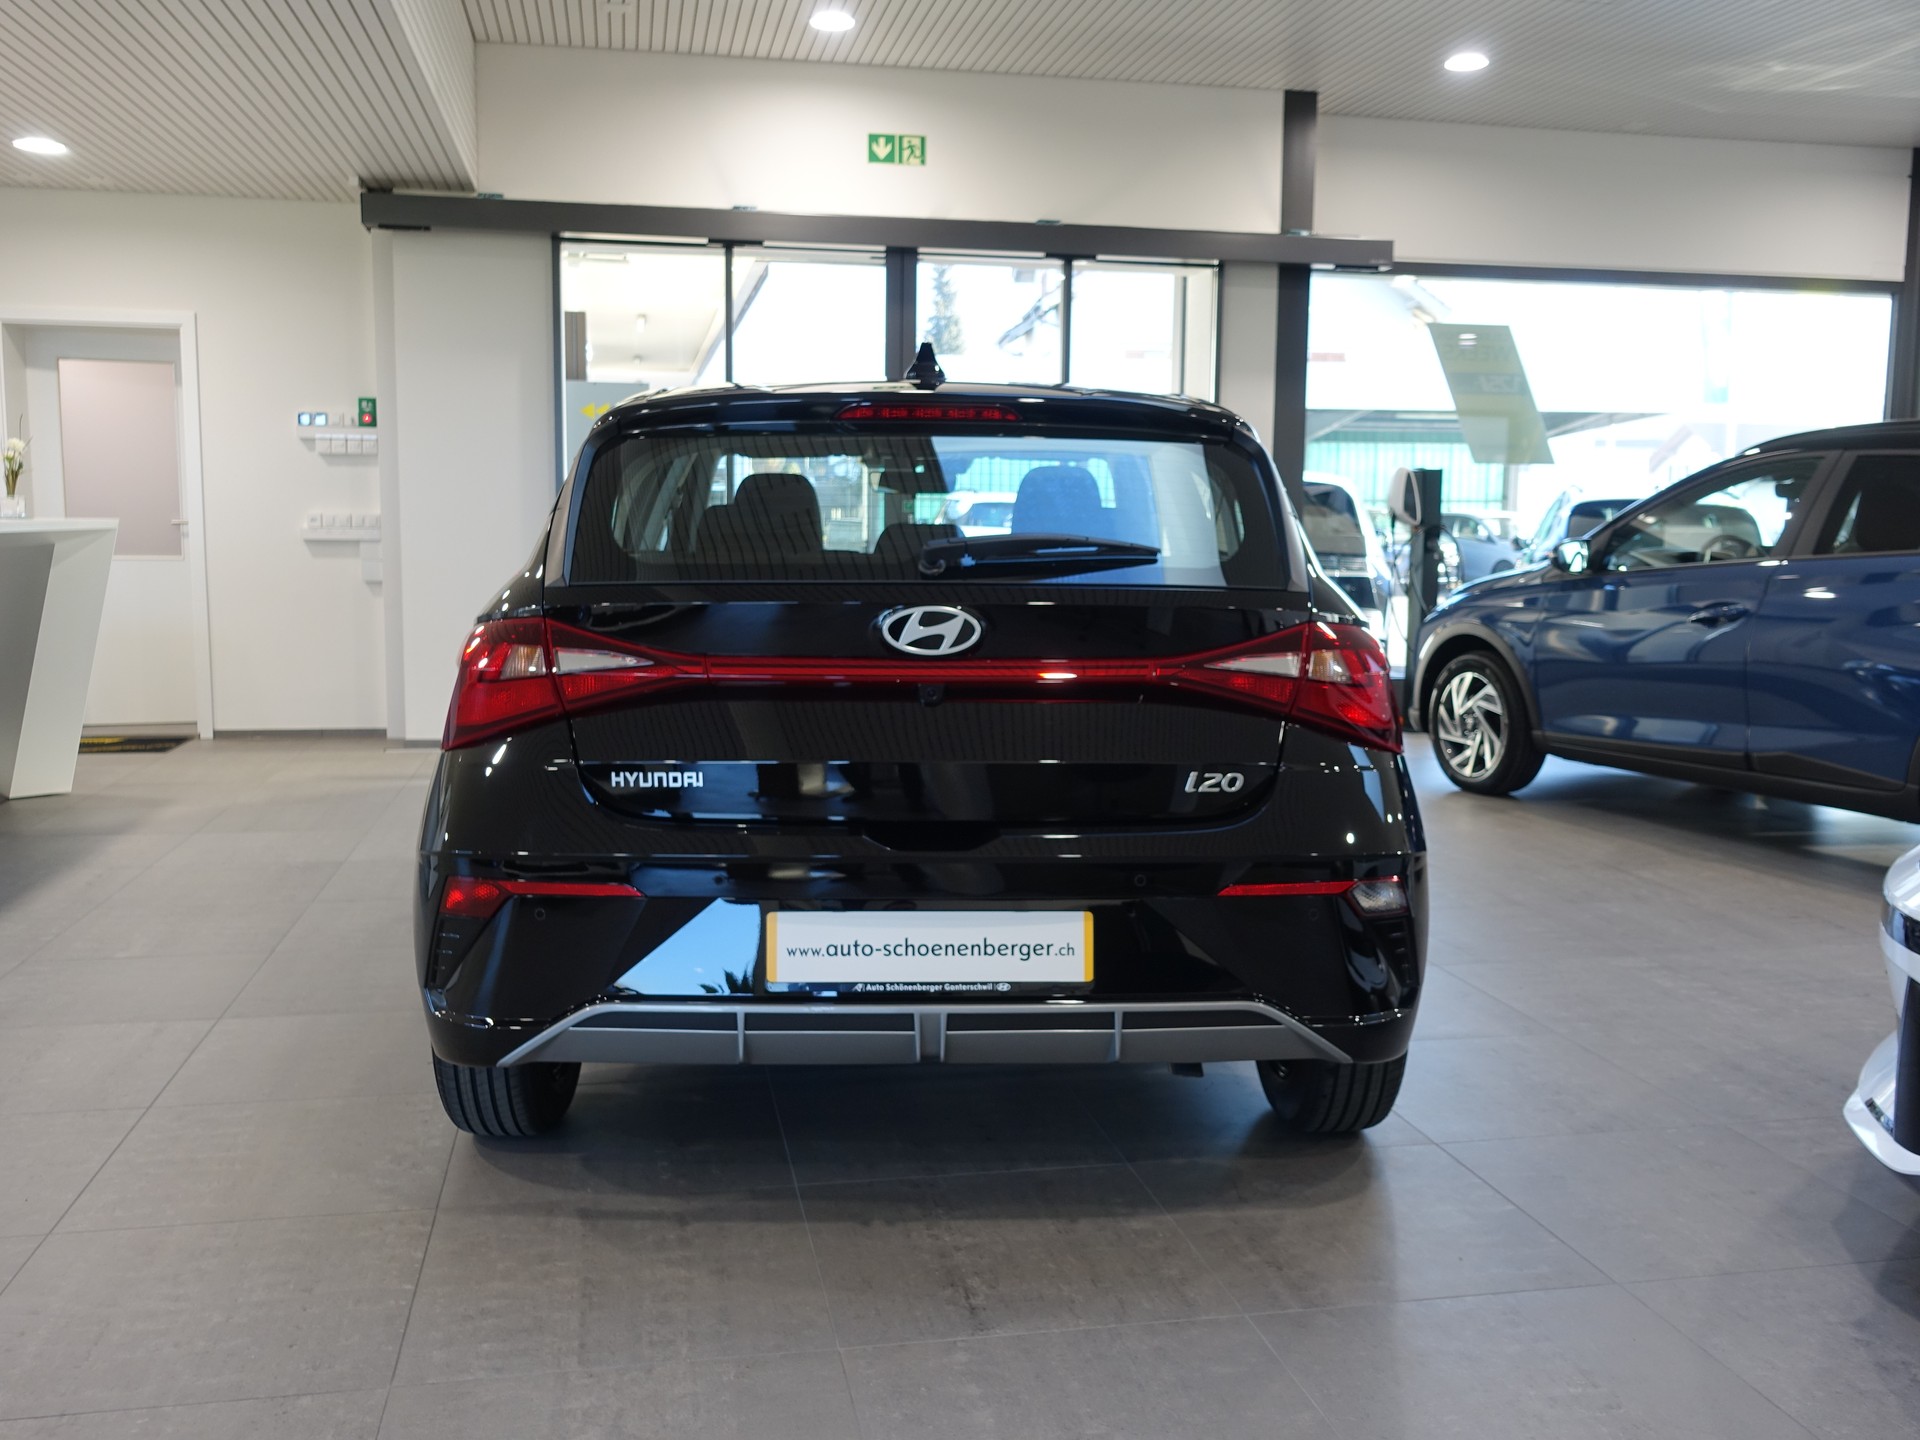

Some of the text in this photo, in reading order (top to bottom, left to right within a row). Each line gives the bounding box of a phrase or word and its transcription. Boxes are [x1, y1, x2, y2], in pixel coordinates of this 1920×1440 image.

[610, 771, 704, 788] HYUNDAI
[786, 938, 1075, 961] www.auto-schoenenberger.ch
[866, 983, 885, 991] Auto
[886, 983, 943, 992] Schönenberger
